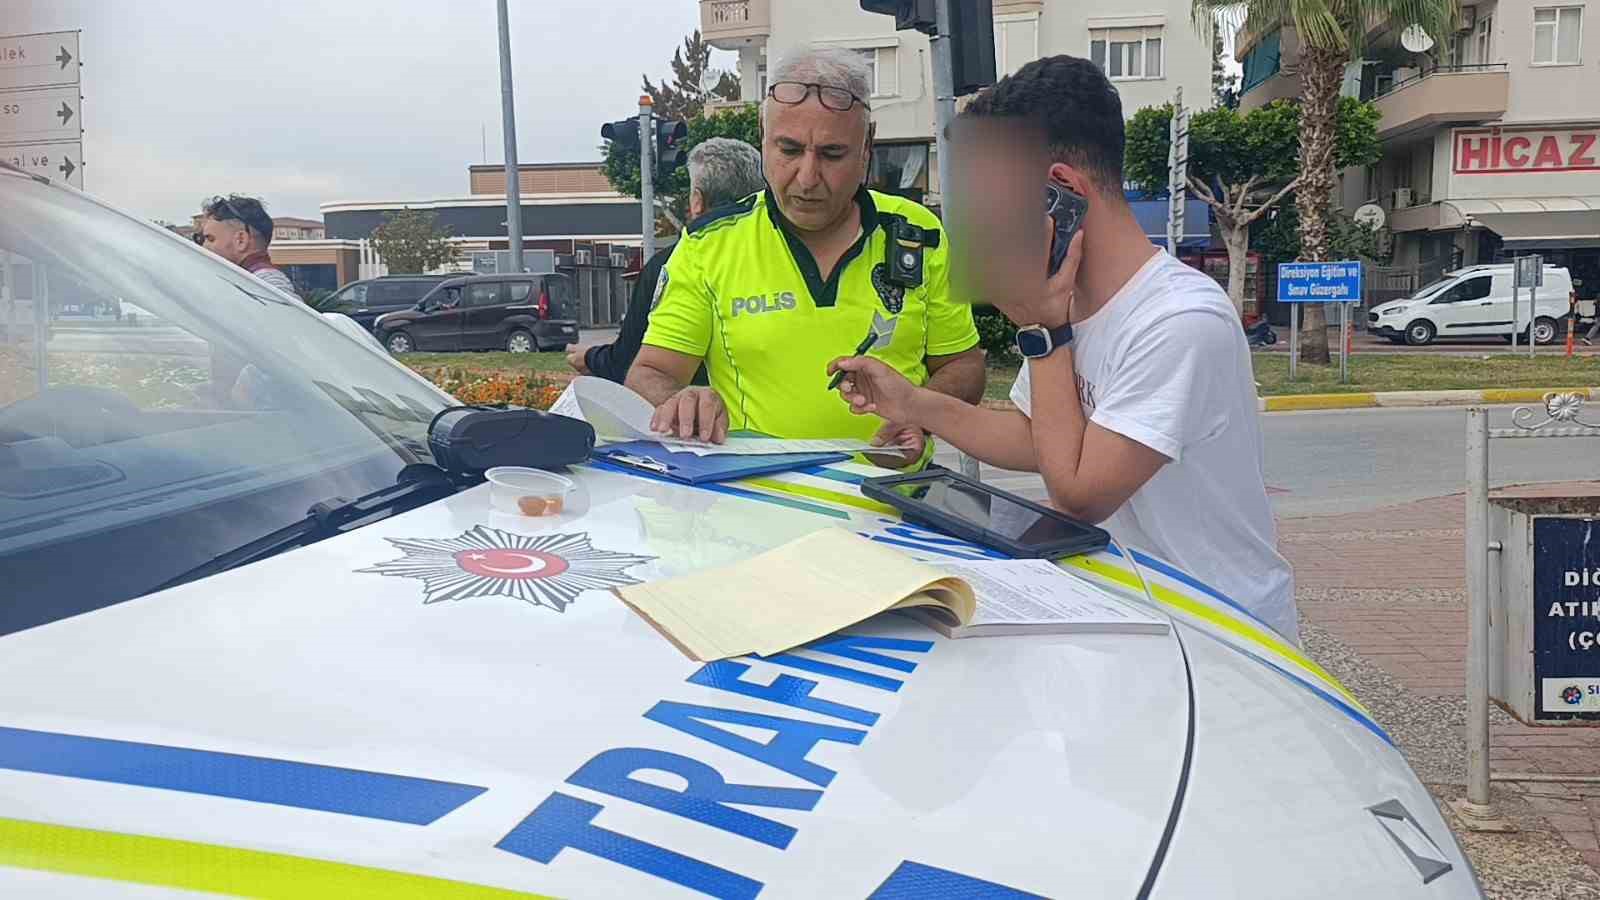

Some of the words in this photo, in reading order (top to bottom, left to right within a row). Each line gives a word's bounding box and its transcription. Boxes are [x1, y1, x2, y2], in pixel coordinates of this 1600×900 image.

[1461, 126, 1597, 169] HİCAZ
[31, 156, 49, 167] ve
[1281, 265, 1320, 281] Direksiyon
[1321, 264, 1346, 280] Eğitim
[1347, 267, 1358, 277] ve
[1287, 283, 1308, 296] Sınav
[731, 291, 797, 317] POLİS
